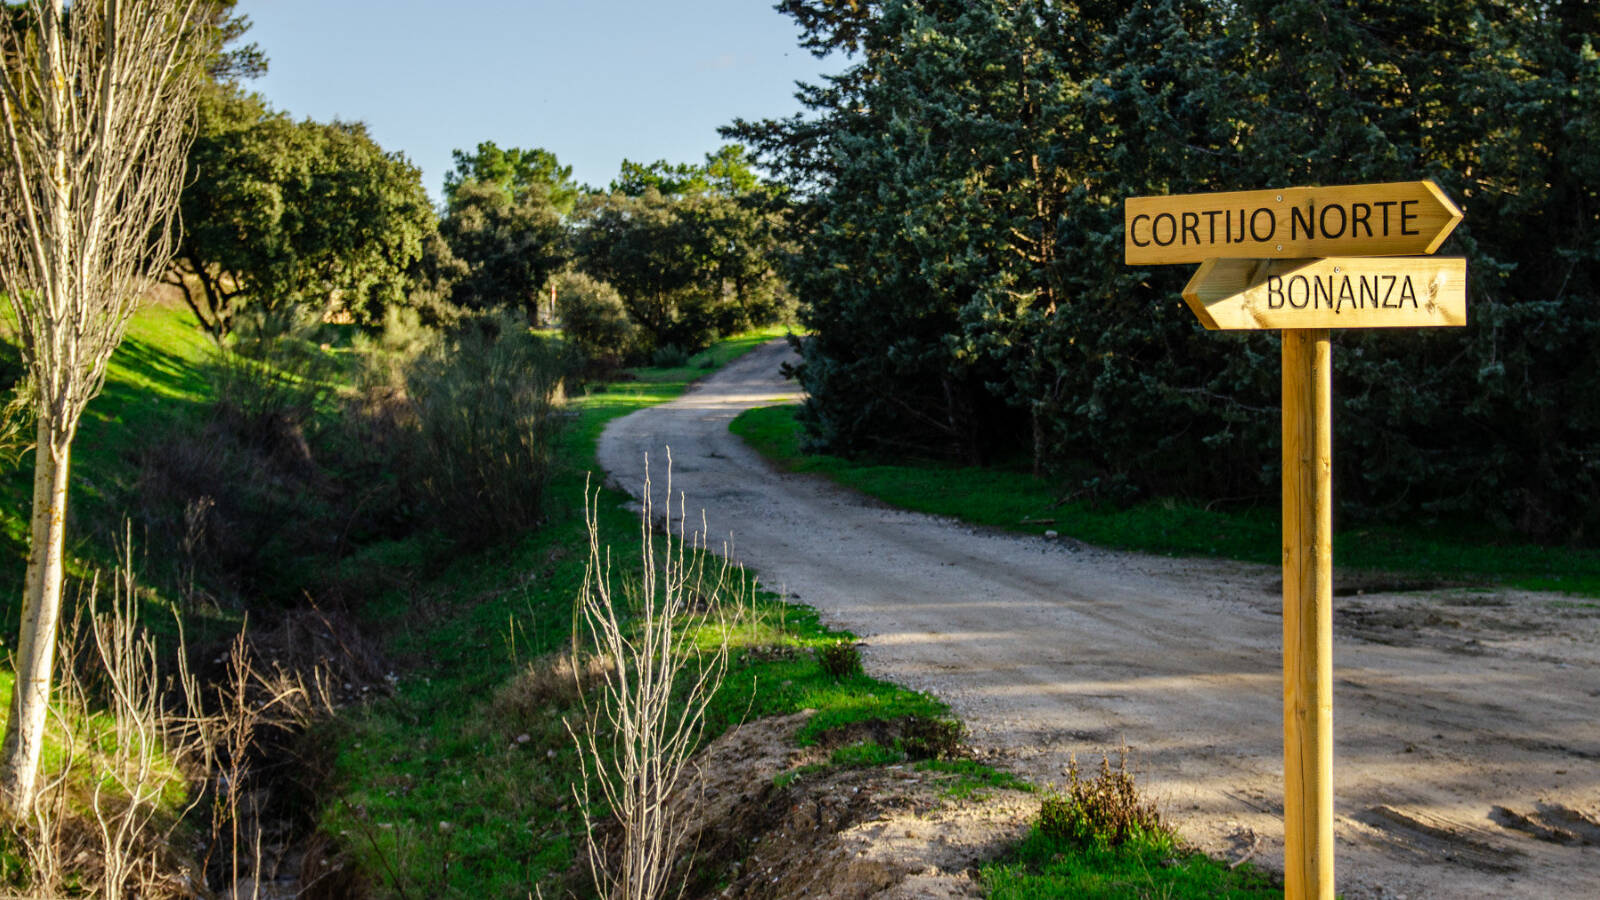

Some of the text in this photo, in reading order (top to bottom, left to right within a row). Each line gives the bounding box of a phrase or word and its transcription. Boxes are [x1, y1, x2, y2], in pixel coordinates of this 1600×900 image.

[1130, 200, 1420, 247] CORTIJO NORTE
[1267, 275, 1418, 310] BONANZA
